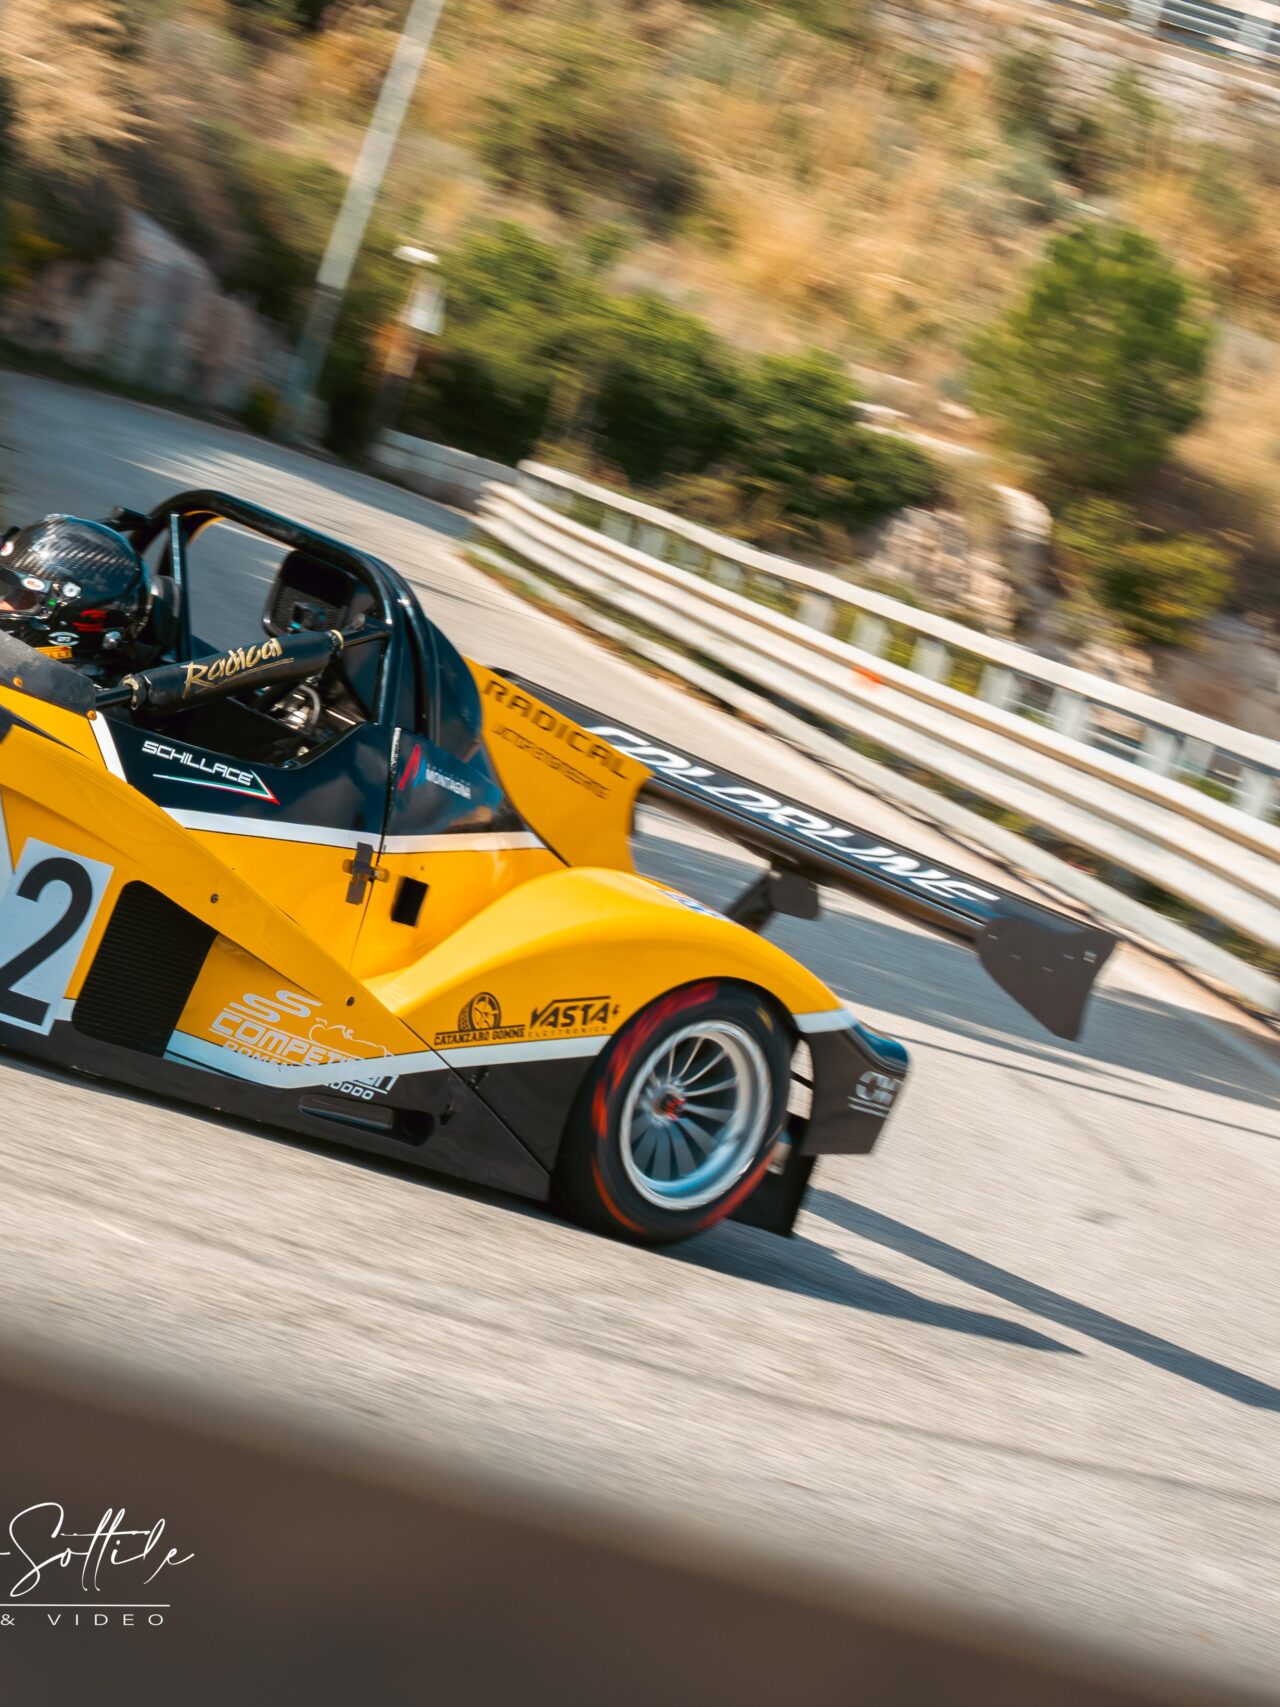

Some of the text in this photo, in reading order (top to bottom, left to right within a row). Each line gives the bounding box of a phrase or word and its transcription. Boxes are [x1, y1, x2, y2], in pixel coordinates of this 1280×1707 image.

[180, 637, 286, 699] Radical
[483, 679, 629, 780] RADICAL
[142, 740, 254, 786] SCHILLACE
[229, 990, 323, 1023] SS
[530, 998, 610, 1028] VASTA
[434, 1031, 490, 1046] CATANZARO
